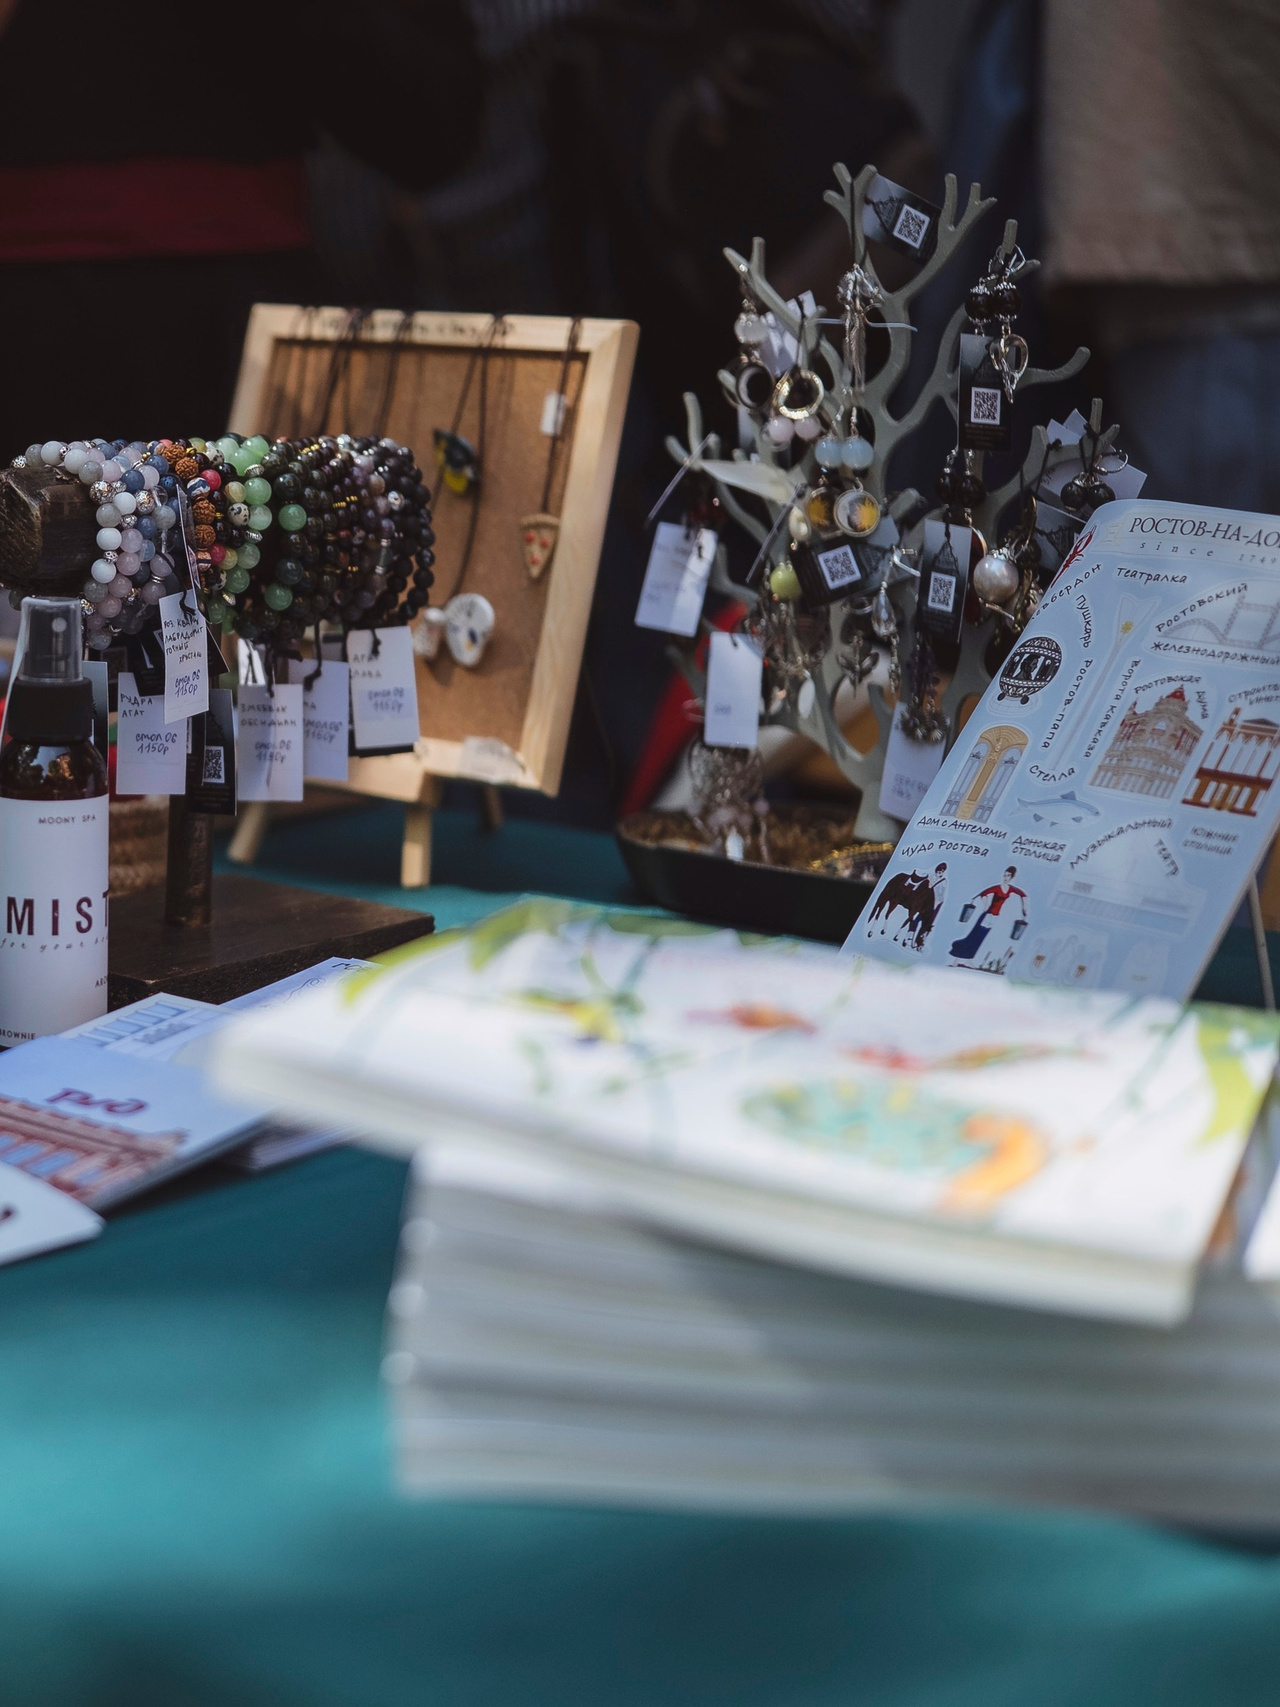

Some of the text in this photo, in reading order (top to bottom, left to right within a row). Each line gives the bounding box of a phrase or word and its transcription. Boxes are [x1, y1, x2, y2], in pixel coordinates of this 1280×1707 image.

[1128, 516, 1280, 549] РОСТОВ-НА-ДО
[1140, 541, 1214, 557] since
[1075, 594, 1092, 649] Пушкарь
[121, 709, 145, 718] АГАТ
[1029, 764, 1076, 782] Стелла
[38, 814, 96, 824] MOONY SPA
[917, 815, 940, 827] Дом
[947, 819, 1008, 840] Ангелами
